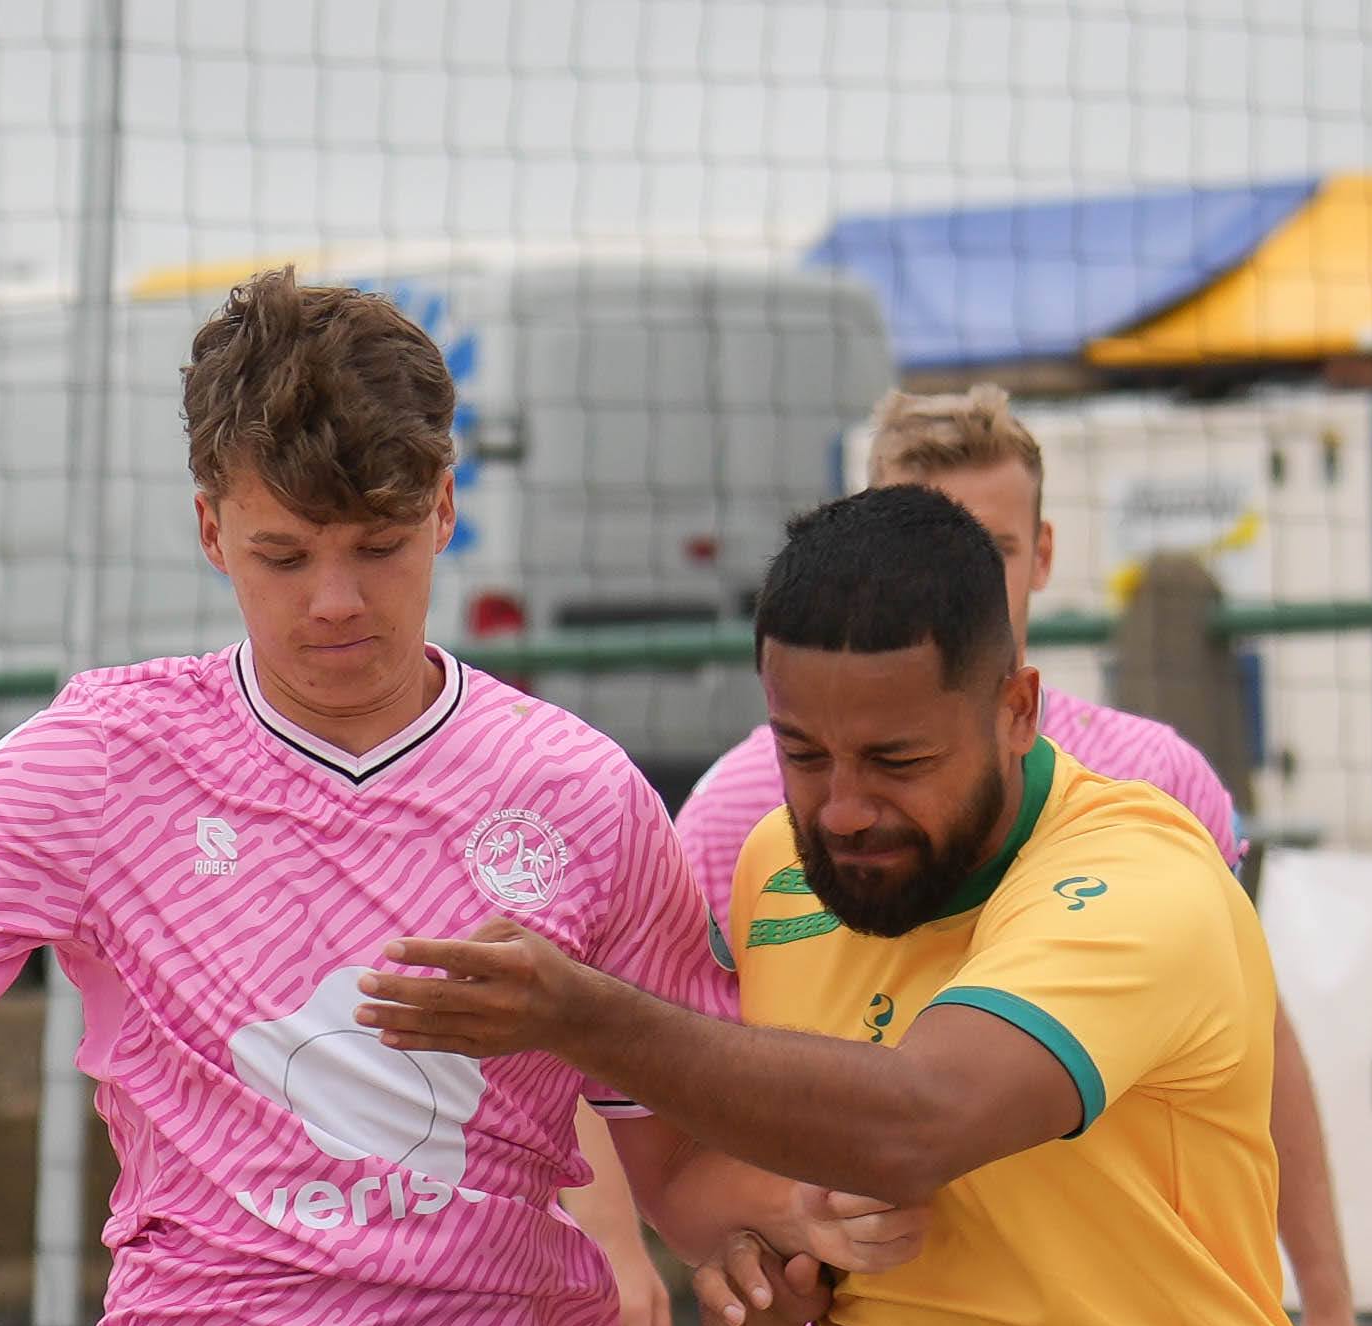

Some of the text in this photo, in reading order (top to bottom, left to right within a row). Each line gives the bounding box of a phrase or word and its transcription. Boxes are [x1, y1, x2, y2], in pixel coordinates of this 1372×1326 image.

[194, 860, 238, 876] ROBEY
[464, 808, 569, 868] BEACH SOCCER ALTENA
[234, 1170, 488, 1231] veris
